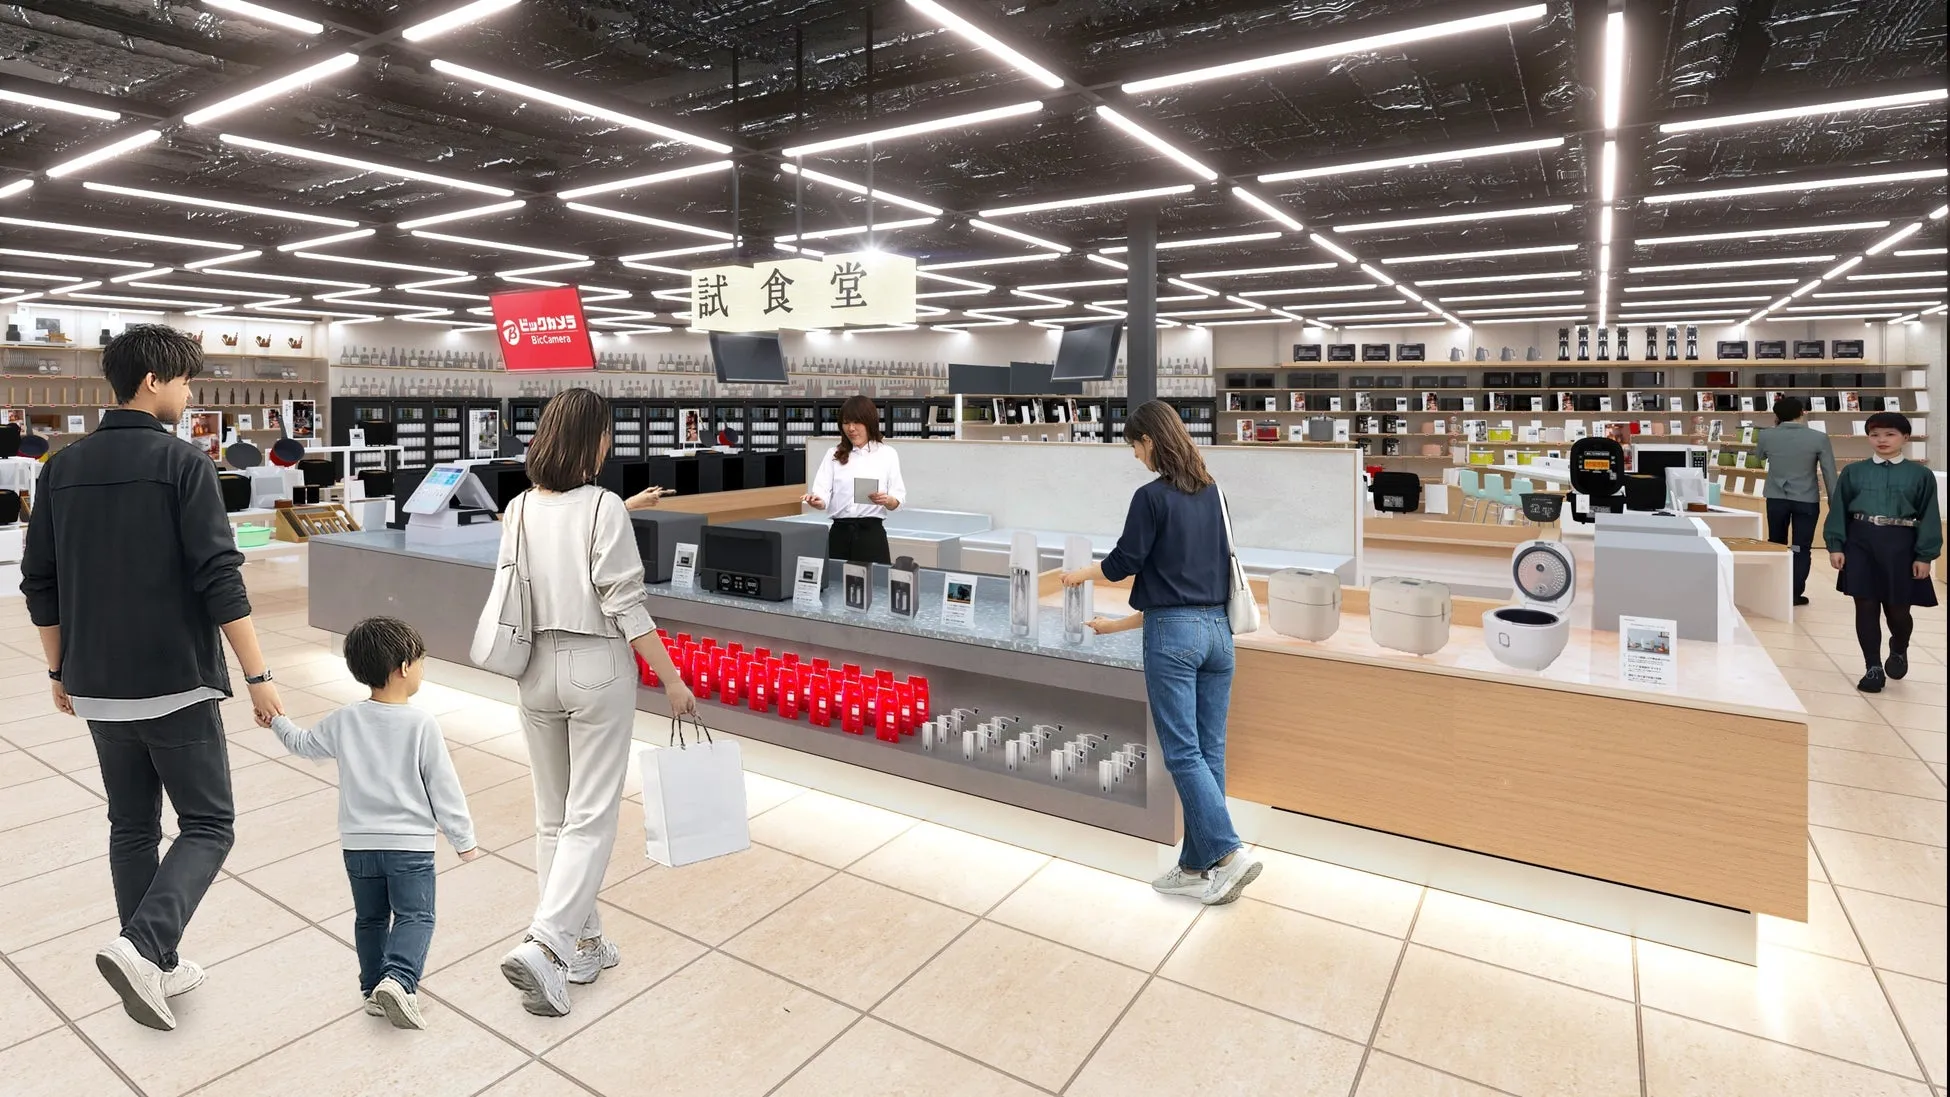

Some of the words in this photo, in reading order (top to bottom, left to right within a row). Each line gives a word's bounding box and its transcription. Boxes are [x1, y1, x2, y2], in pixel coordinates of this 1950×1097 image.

[698, 261, 868, 319] 試食堂
[518, 314, 577, 332] ビックカメラ
[531, 335, 571, 345] BicCamera
